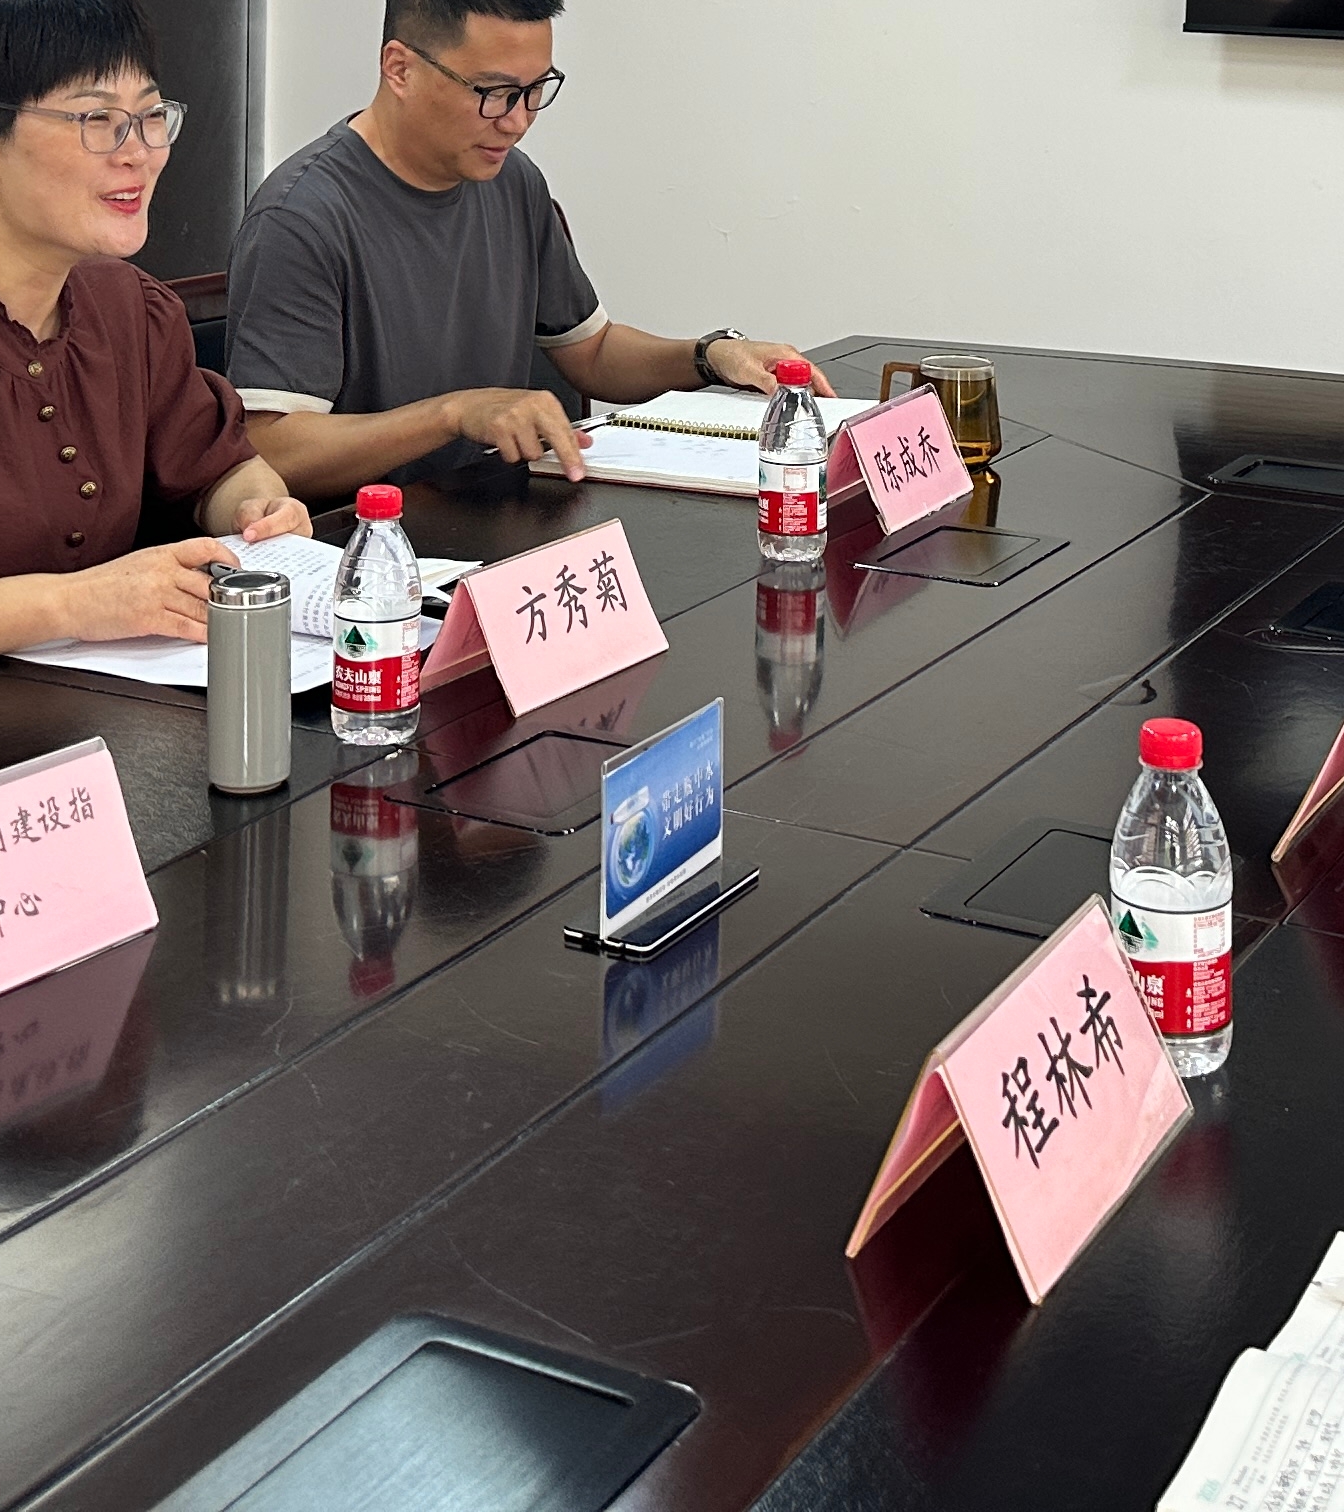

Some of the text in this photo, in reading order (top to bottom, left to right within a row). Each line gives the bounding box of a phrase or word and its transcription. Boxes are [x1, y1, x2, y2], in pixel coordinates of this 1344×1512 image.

[873, 425, 941, 493] 陈成乔
[515, 550, 629, 645] 方秀菊
[335, 664, 382, 685] 农夫山泉
[1001, 974, 1125, 1169] 程林希
